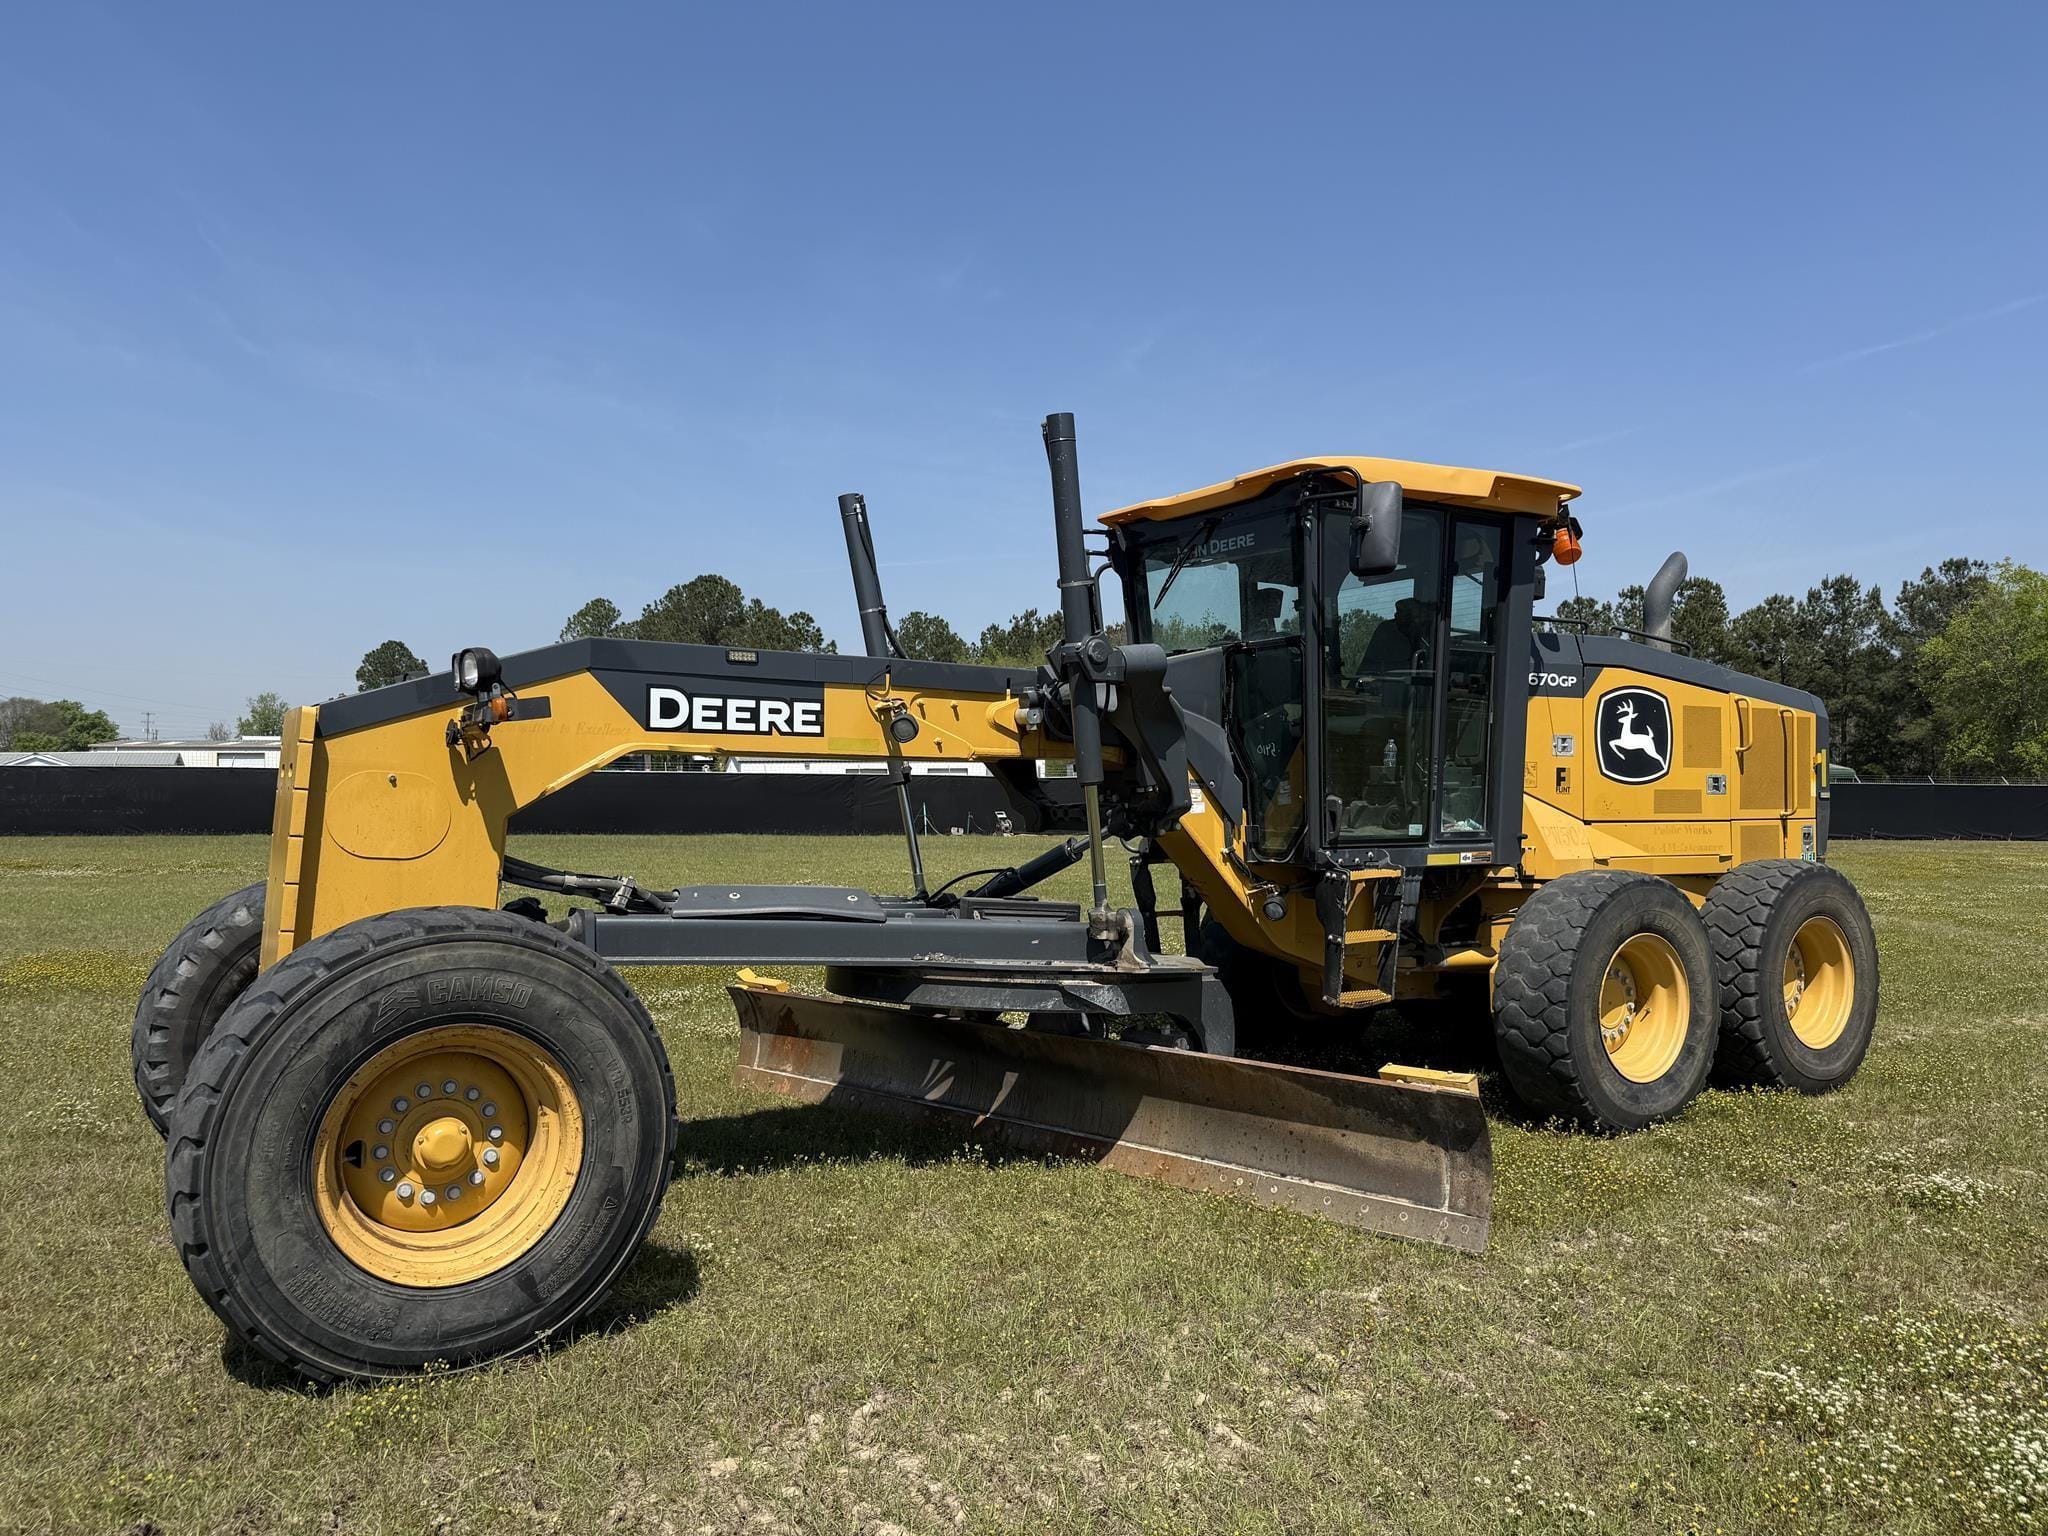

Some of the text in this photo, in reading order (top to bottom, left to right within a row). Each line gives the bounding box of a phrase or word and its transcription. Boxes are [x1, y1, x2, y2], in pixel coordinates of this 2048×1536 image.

[1210, 533, 1256, 555] DEERE
[1528, 672, 1577, 687] 670GP
[649, 687, 822, 734] DEERE
[427, 975, 534, 1009] CAMSO
